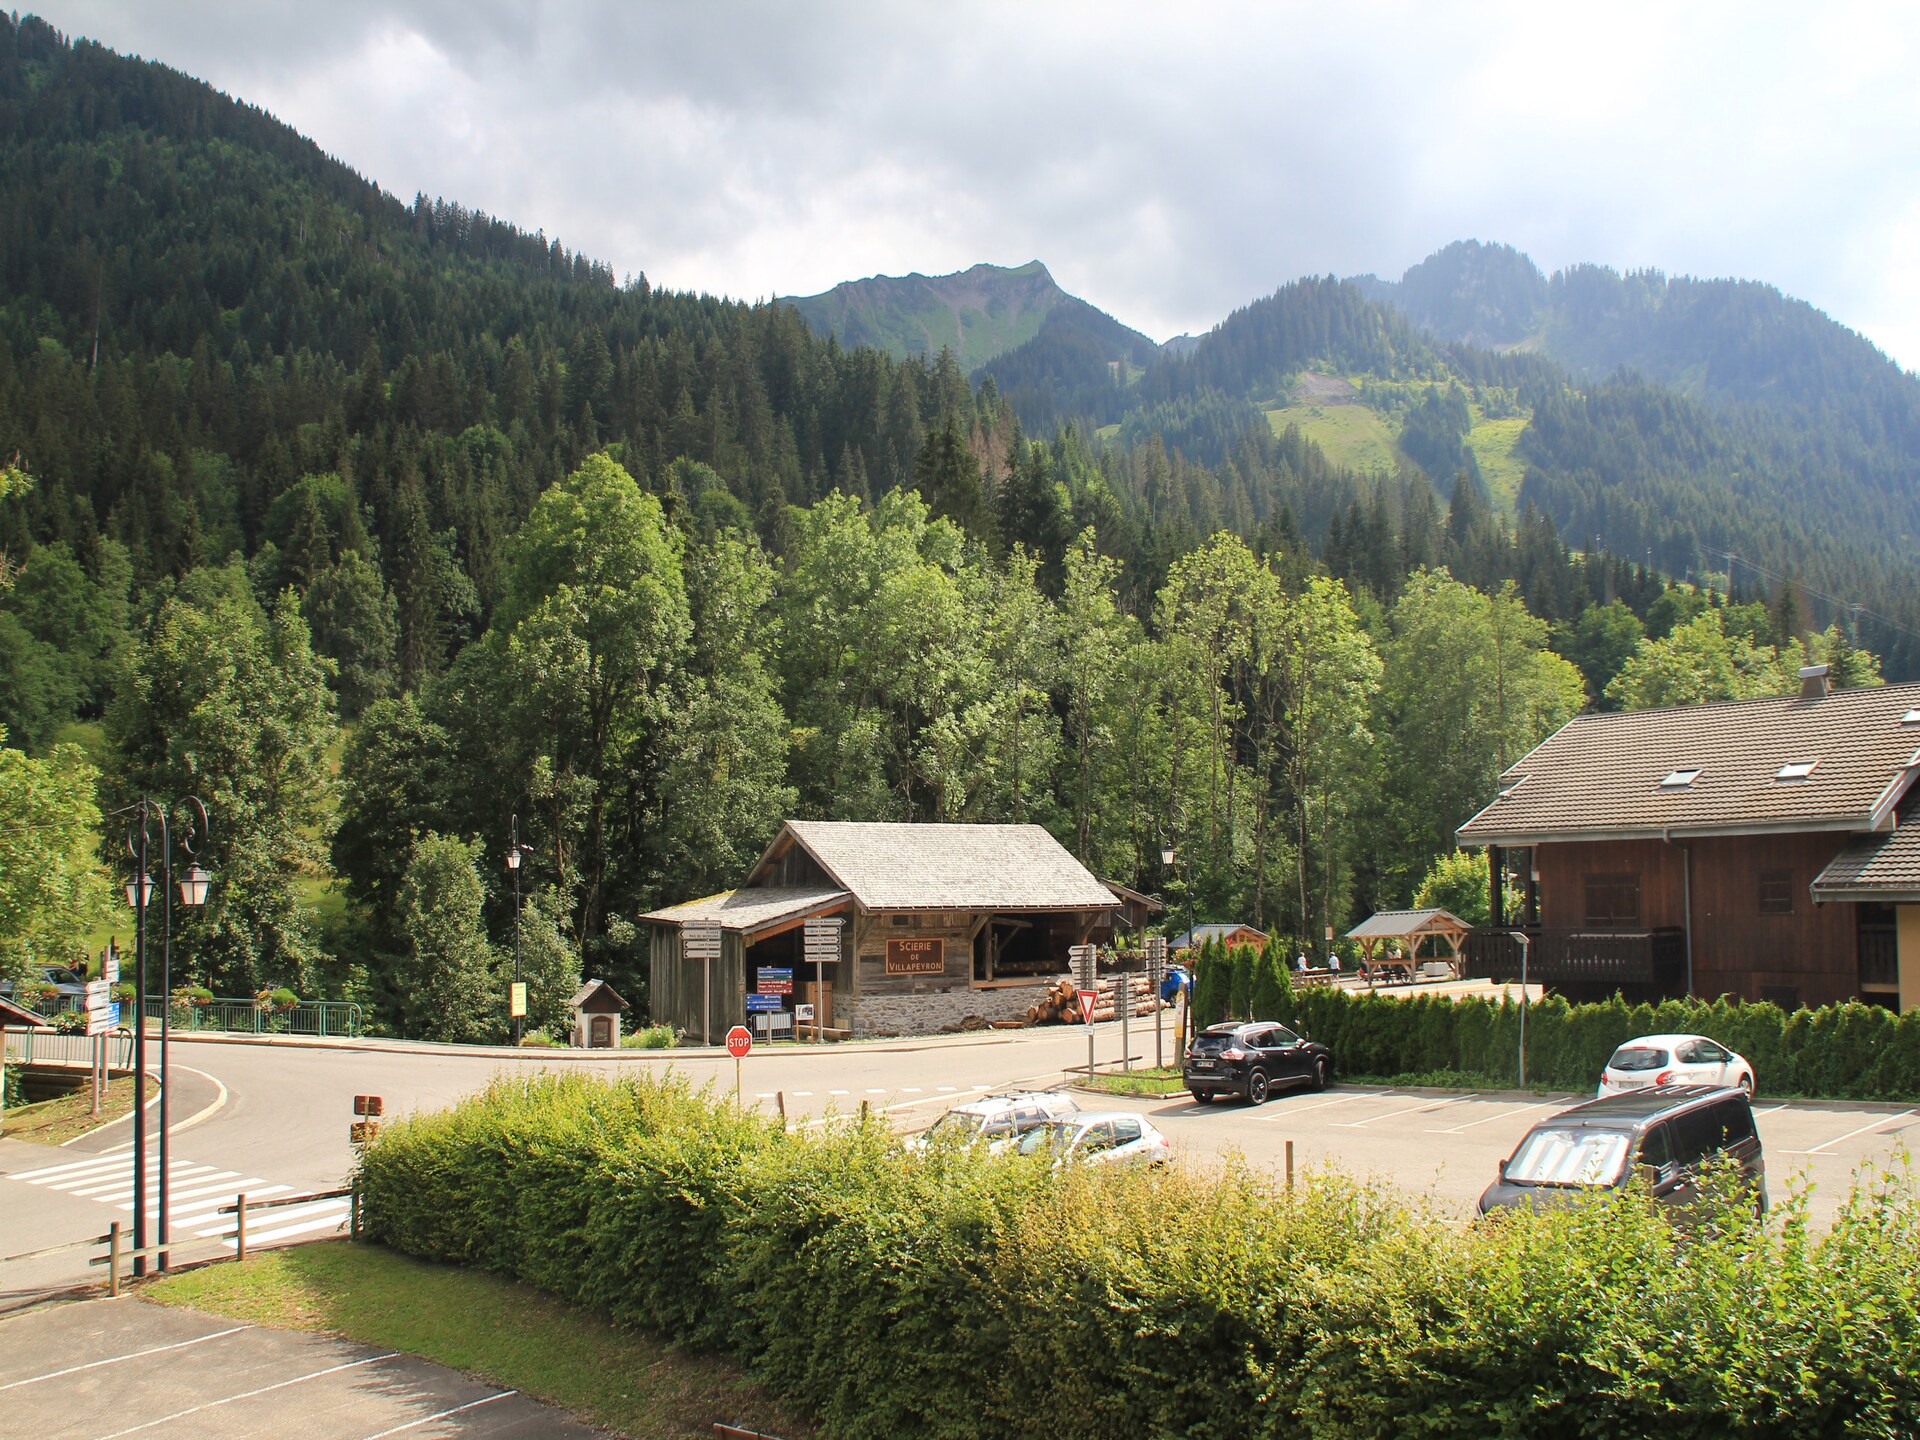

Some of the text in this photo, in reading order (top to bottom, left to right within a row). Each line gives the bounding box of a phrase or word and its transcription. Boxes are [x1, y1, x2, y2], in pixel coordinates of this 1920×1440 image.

[899, 941, 932, 951] SCIERIE
[889, 962, 941, 971] VILLAPEYRON
[729, 1037, 749, 1048] STOP
